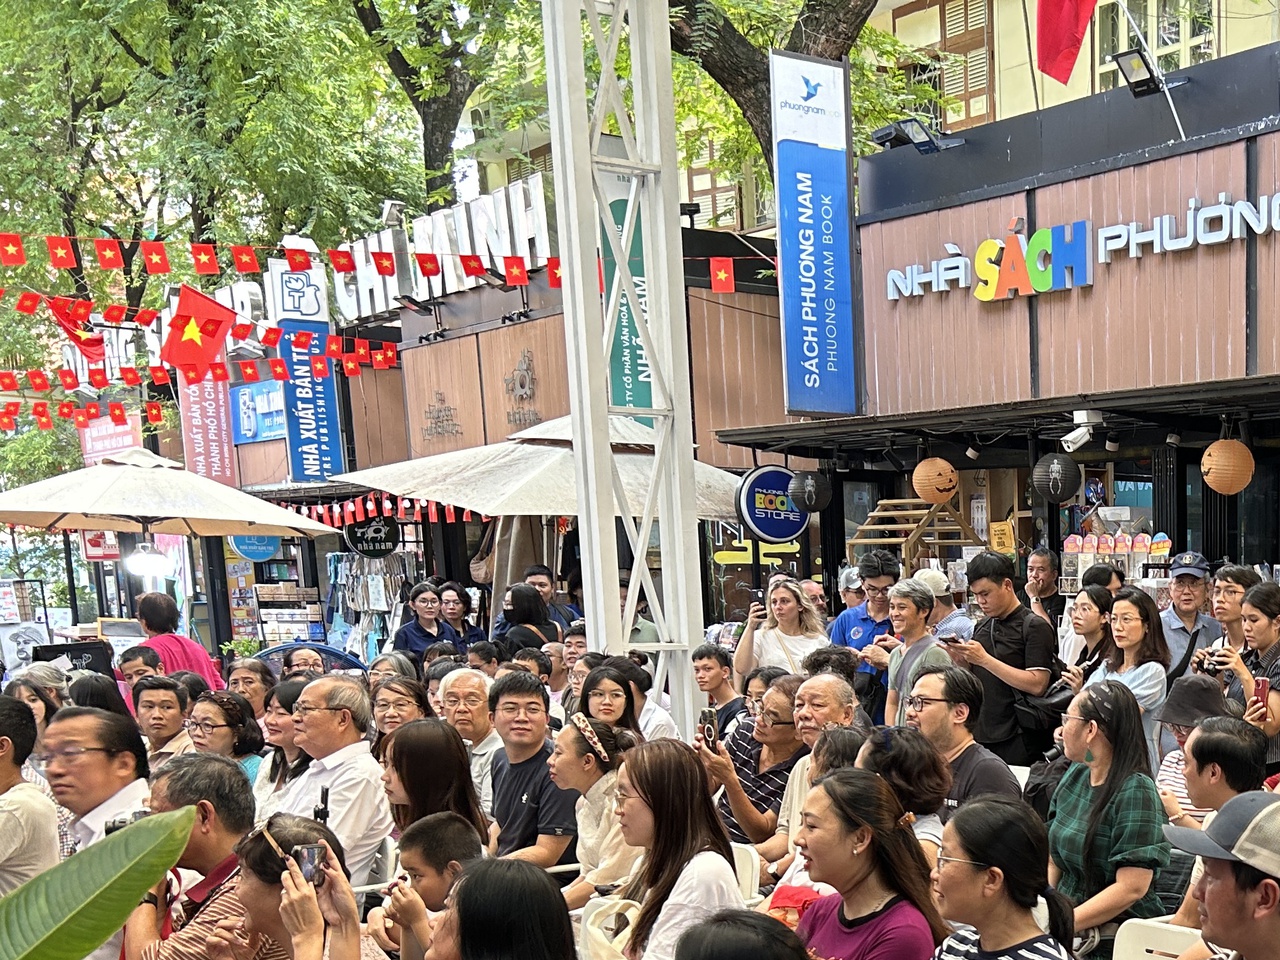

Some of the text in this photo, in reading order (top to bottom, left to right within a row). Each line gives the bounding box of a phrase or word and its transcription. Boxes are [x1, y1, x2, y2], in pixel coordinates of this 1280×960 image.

[412, 171, 558, 302] MINH
[887, 243, 971, 300] NHÀ
[973, 216, 1093, 302] SÁCH
[796, 172, 820, 388] SÁCH PHƯƠNG NAM
[820, 194, 838, 371] PHUONG NAM BOOK
[289, 365, 313, 399] BẢN
[292, 401, 319, 440] XUẤT
[314, 377, 330, 450] PUBLISHING
[193, 455, 207, 477] NHÀ
[208, 442, 222, 477] THÀNH
[298, 443, 321, 476] NHÀ
[755, 508, 800, 521] STORE
[375, 542, 393, 550] nam
